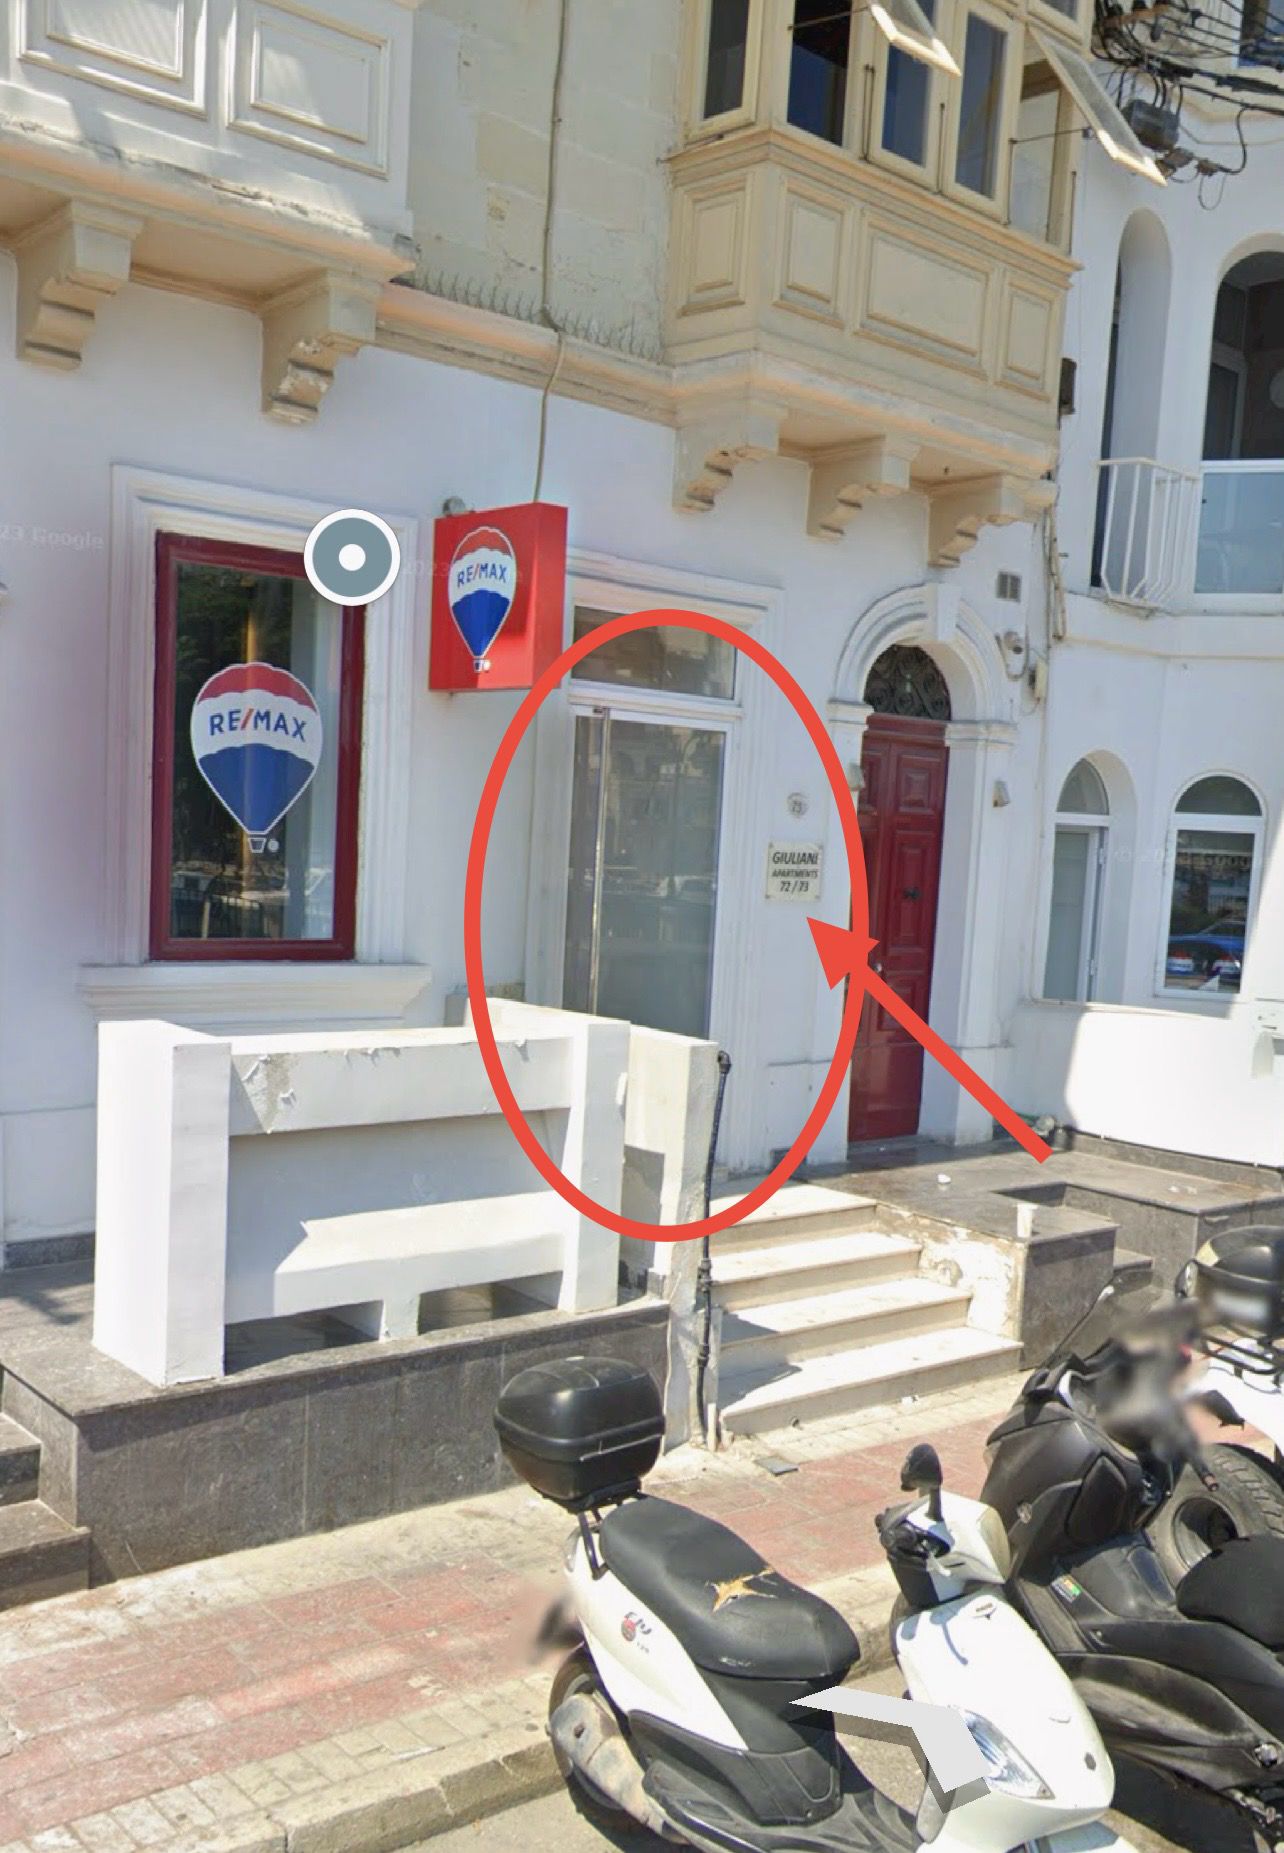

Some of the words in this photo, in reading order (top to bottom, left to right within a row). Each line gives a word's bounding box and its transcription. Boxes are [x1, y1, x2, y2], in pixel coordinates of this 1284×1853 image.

[457, 562, 508, 588] RE/MAX
[208, 708, 306, 742] RE/MAX
[772, 851, 819, 865] GIULIANI
[771, 868, 819, 879] APARTMENTS
